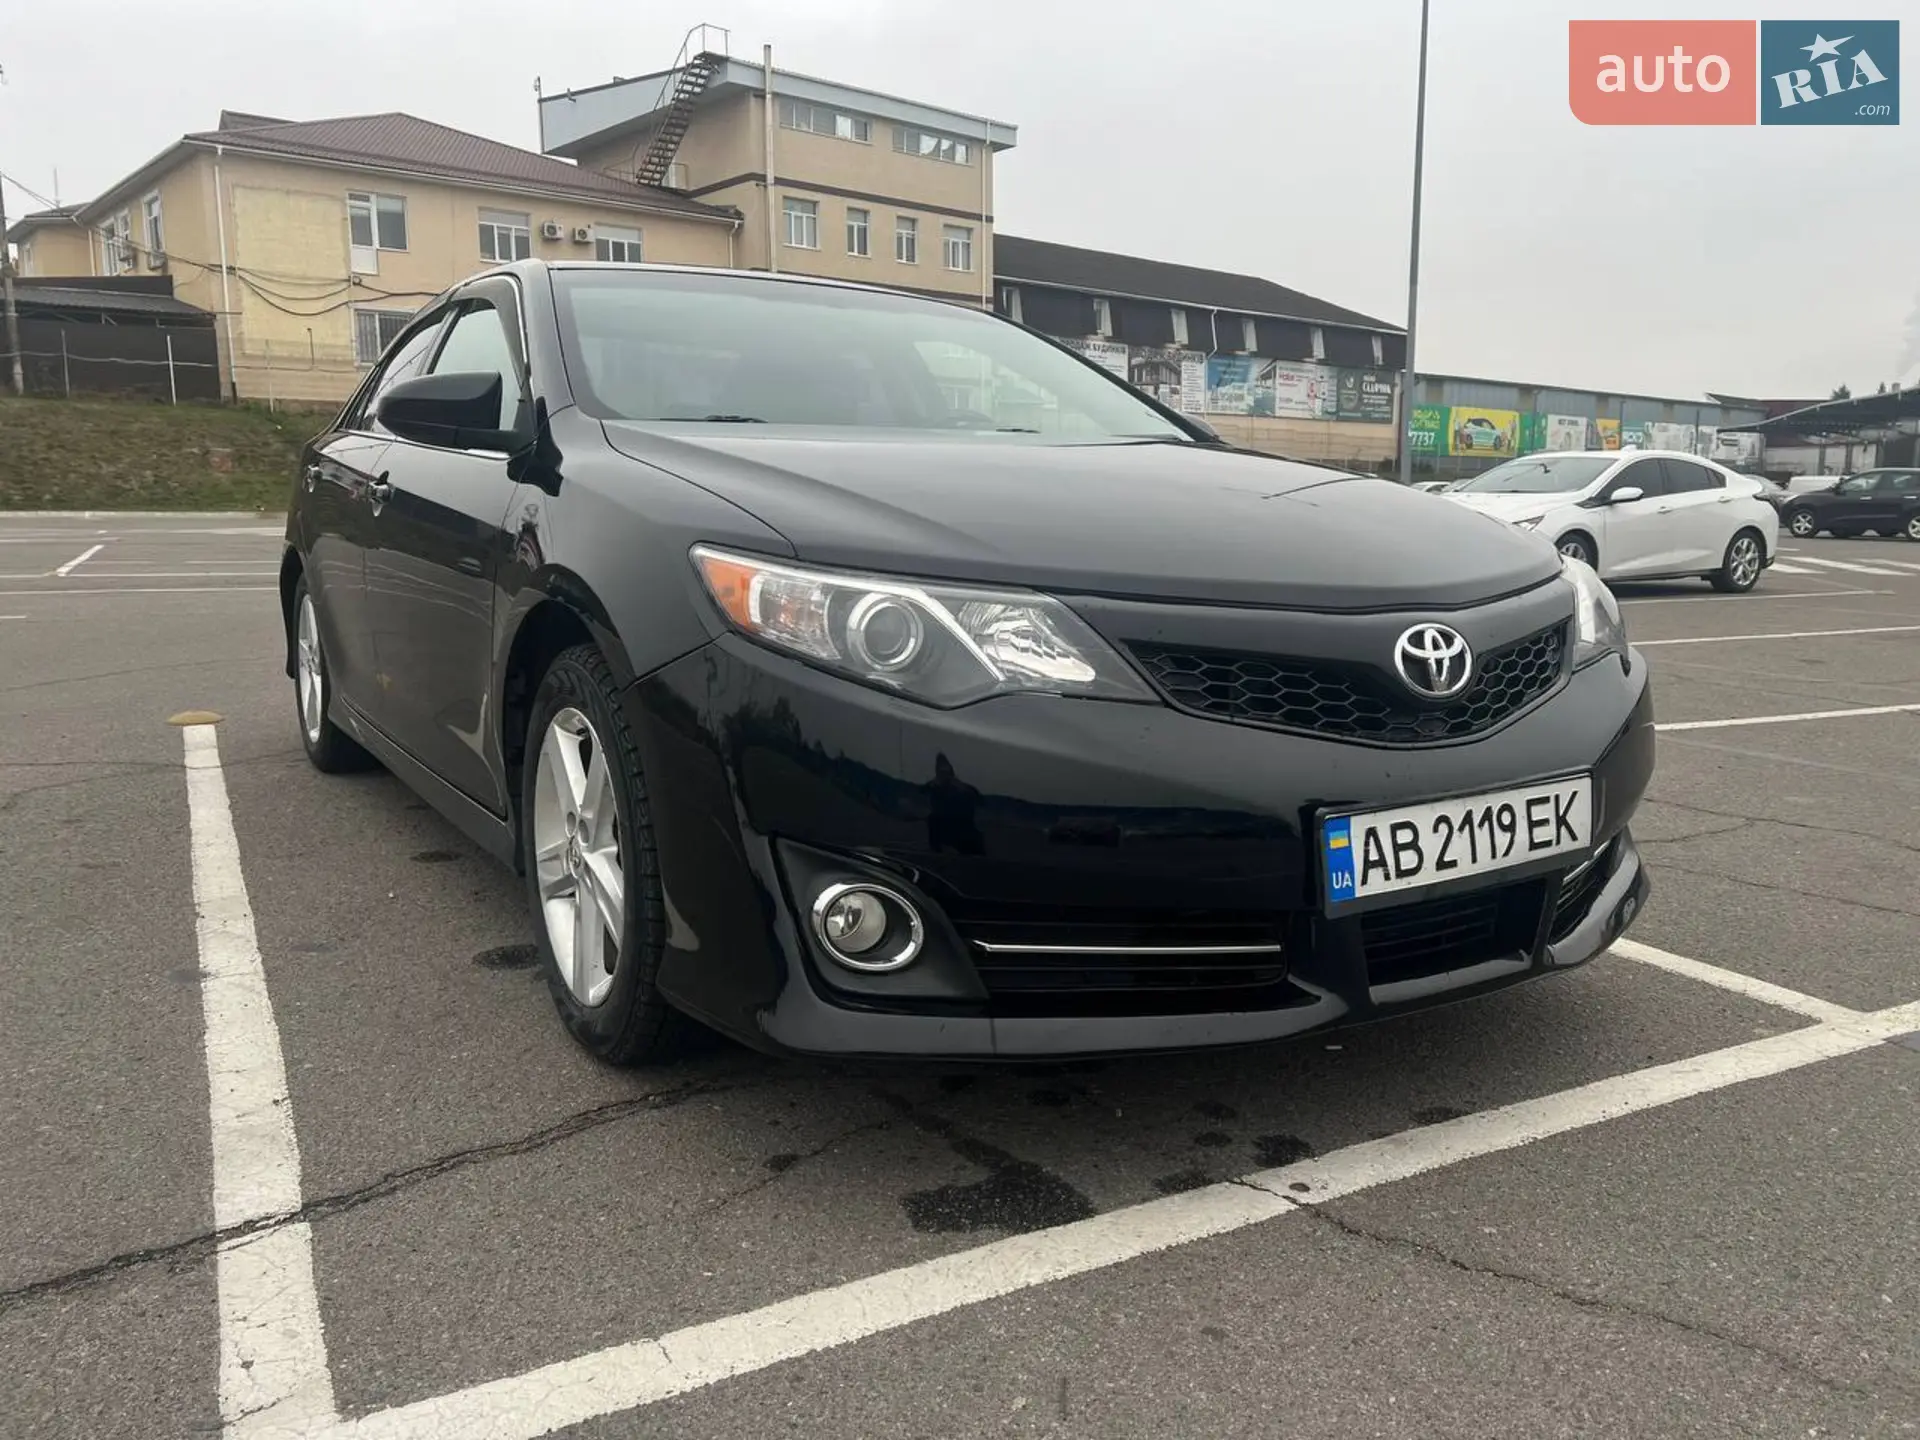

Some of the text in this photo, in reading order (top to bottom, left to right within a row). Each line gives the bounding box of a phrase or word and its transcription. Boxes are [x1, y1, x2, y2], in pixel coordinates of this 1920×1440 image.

[1360, 790, 1579, 886] AB 2119 EK
[1332, 871, 1353, 889] UA
